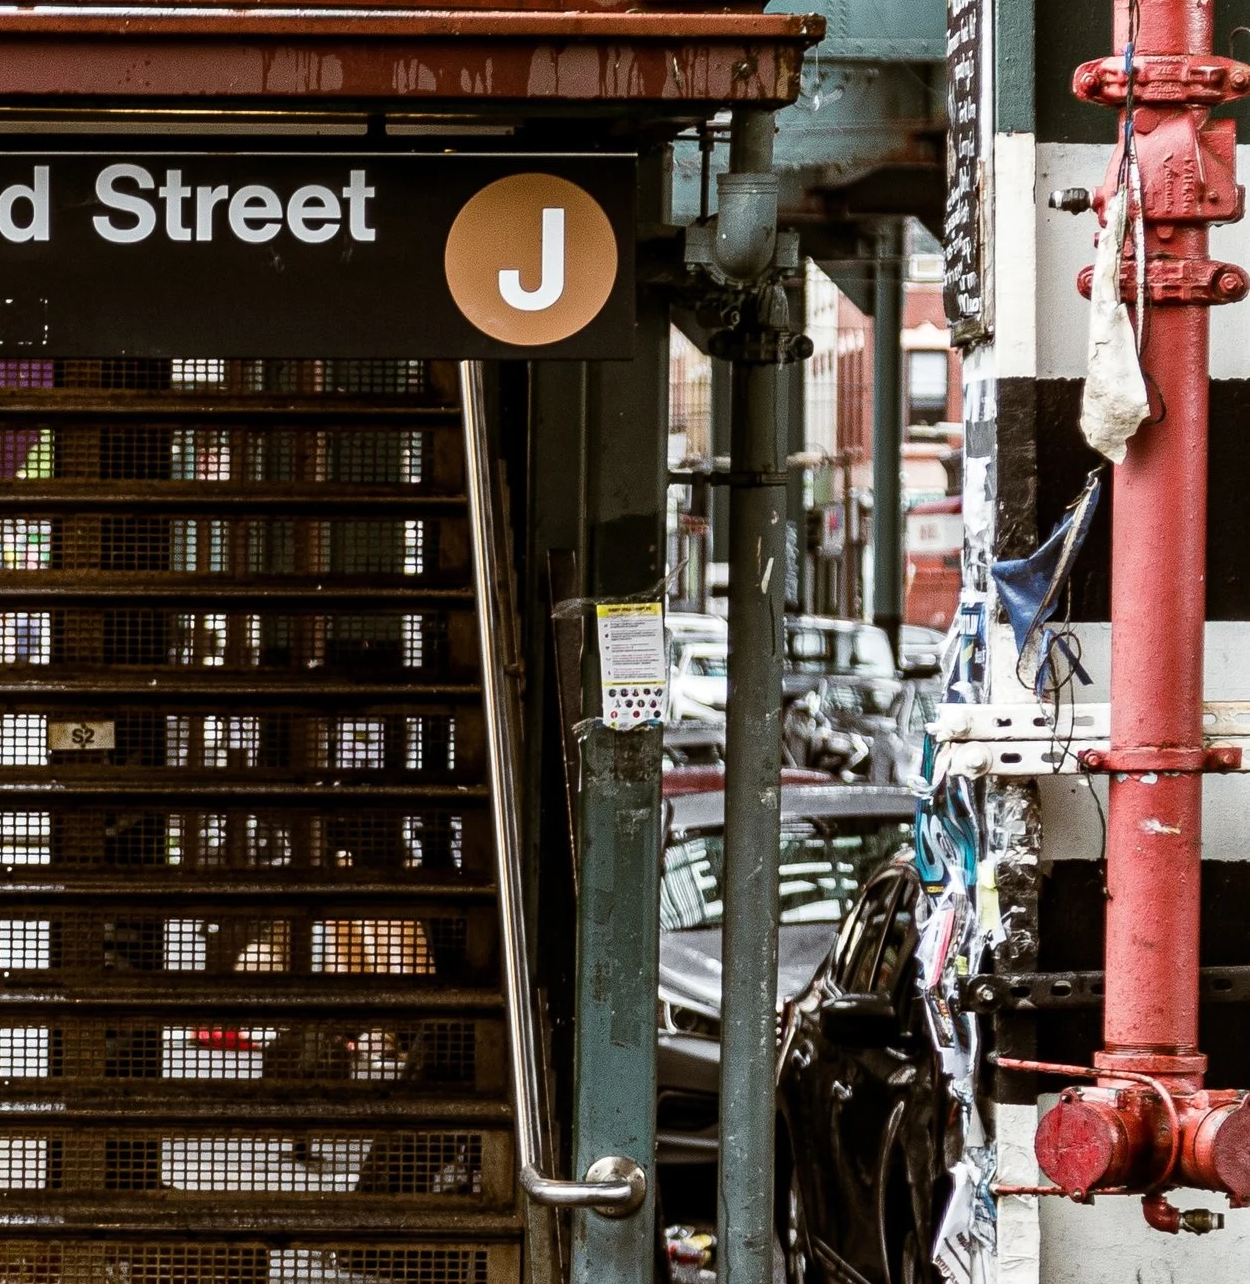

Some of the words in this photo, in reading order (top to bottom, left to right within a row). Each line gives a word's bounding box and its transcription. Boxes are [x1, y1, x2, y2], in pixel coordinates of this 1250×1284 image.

[93, 164, 375, 243] Street
[499, 209, 564, 310] J
[71, 728, 95, 744] S2
